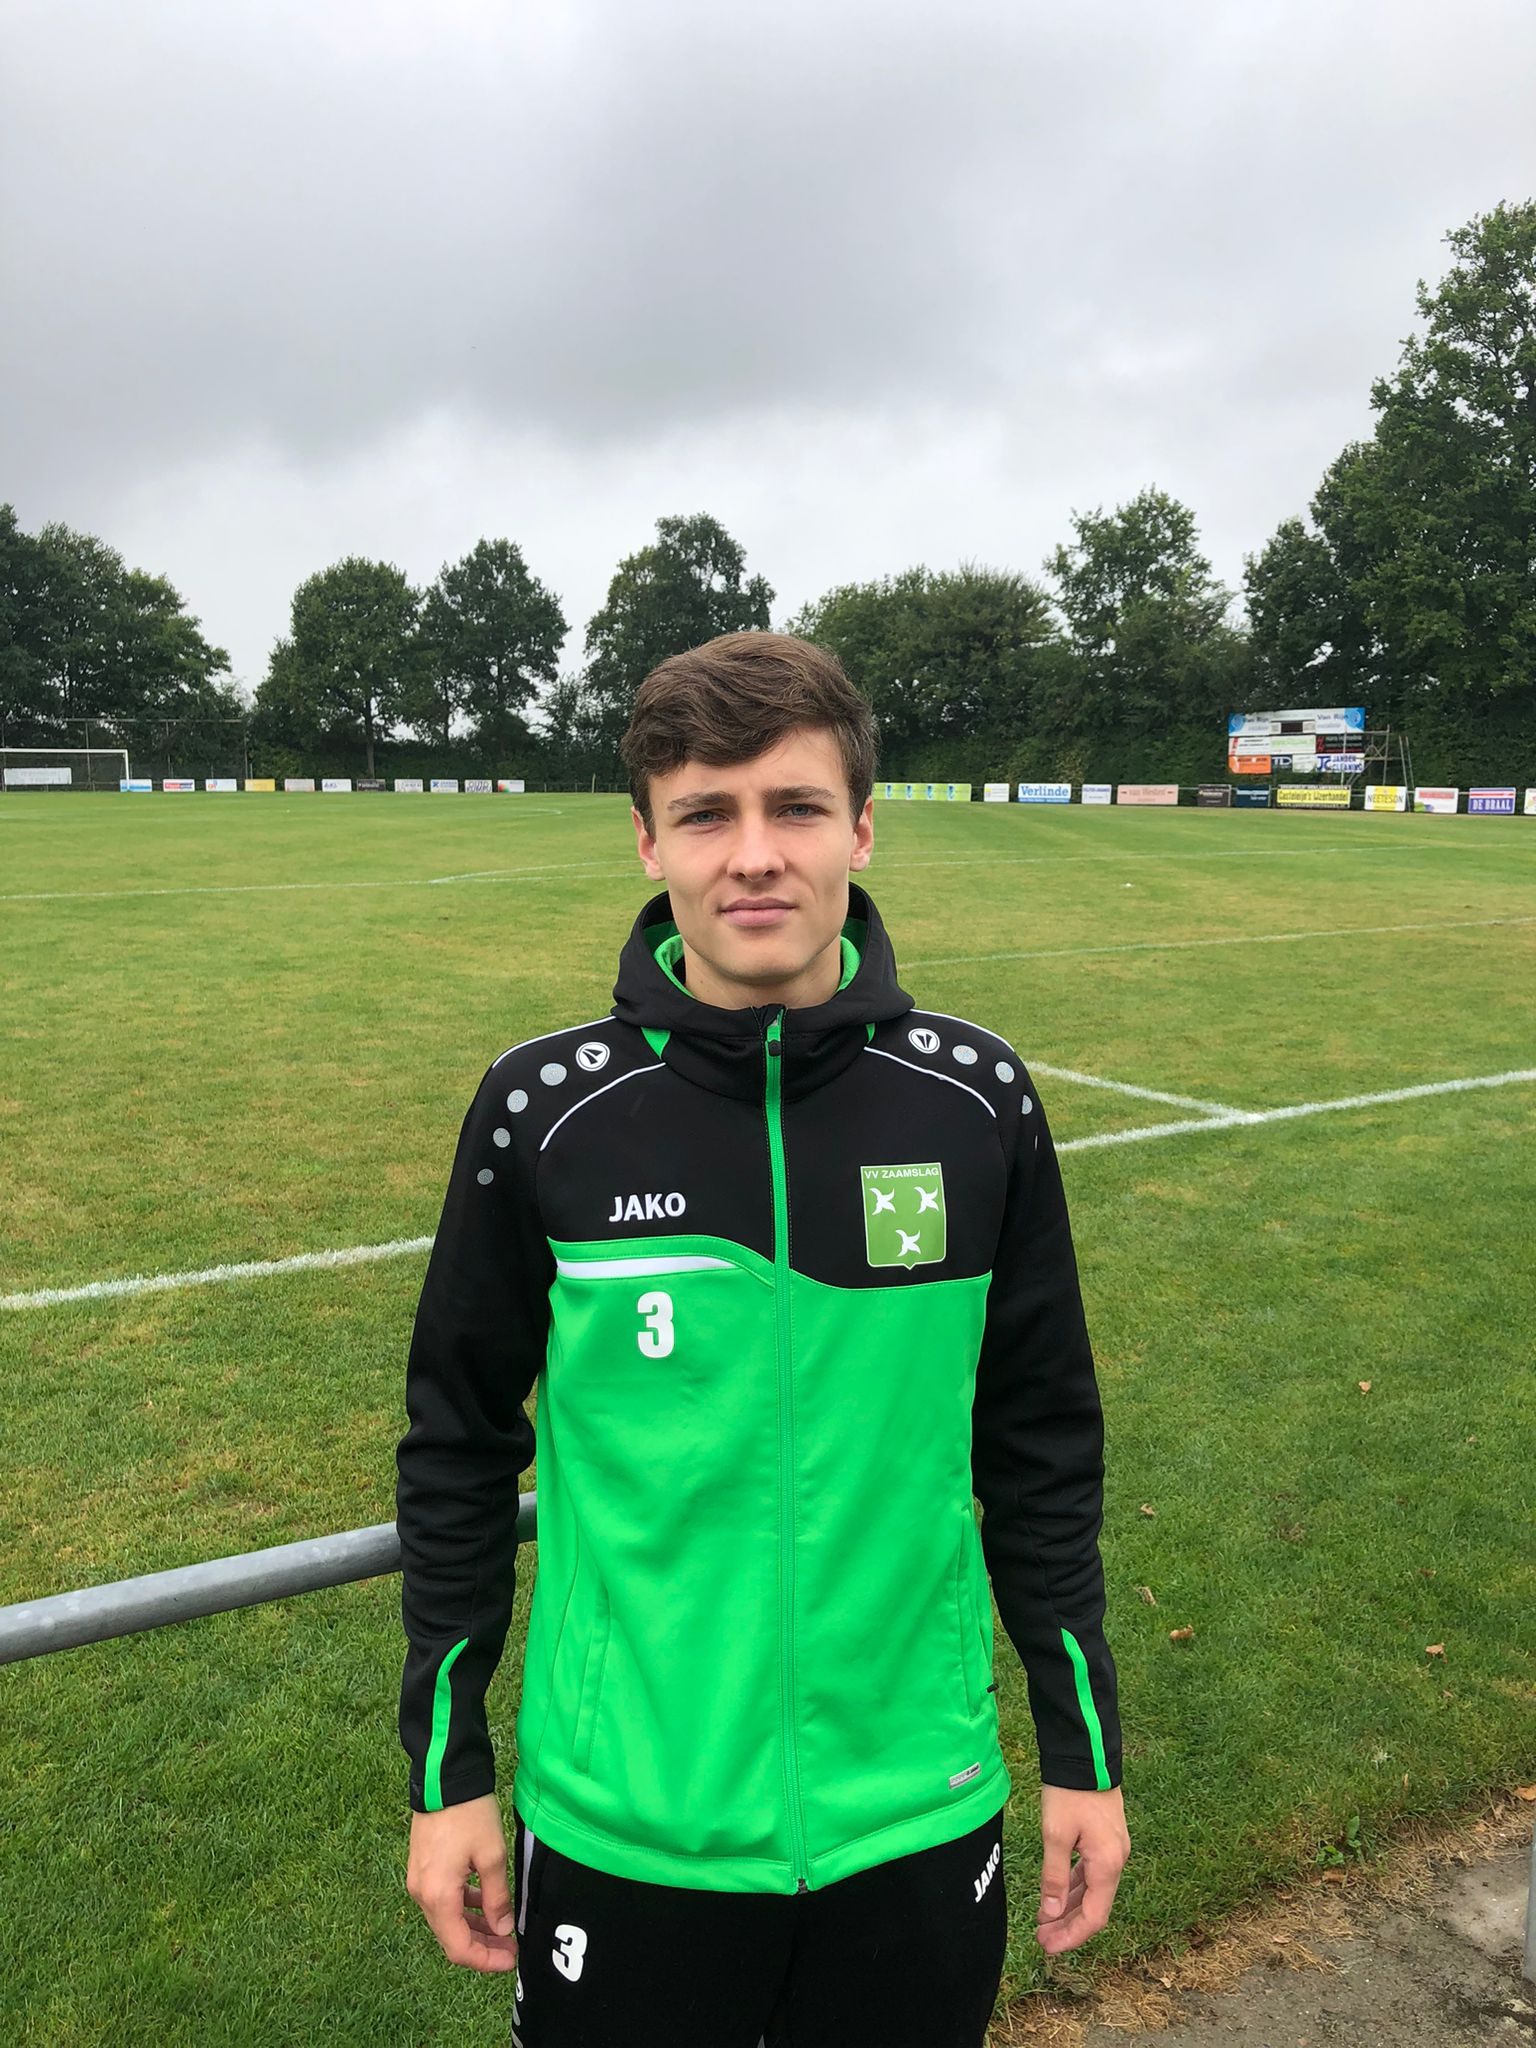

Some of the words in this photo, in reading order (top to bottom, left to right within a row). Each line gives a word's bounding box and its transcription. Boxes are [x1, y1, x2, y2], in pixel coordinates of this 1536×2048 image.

[1020, 785, 1069, 797] Verlinde
[1472, 798, 1483, 810] DE
[863, 1168, 880, 1180] VV
[881, 1167, 940, 1181] ZAAMSLAG
[607, 1191, 688, 1223] JAKO
[636, 1290, 676, 1360] 3
[972, 1841, 1003, 1905] JAKO
[550, 1922, 589, 1983] 3
